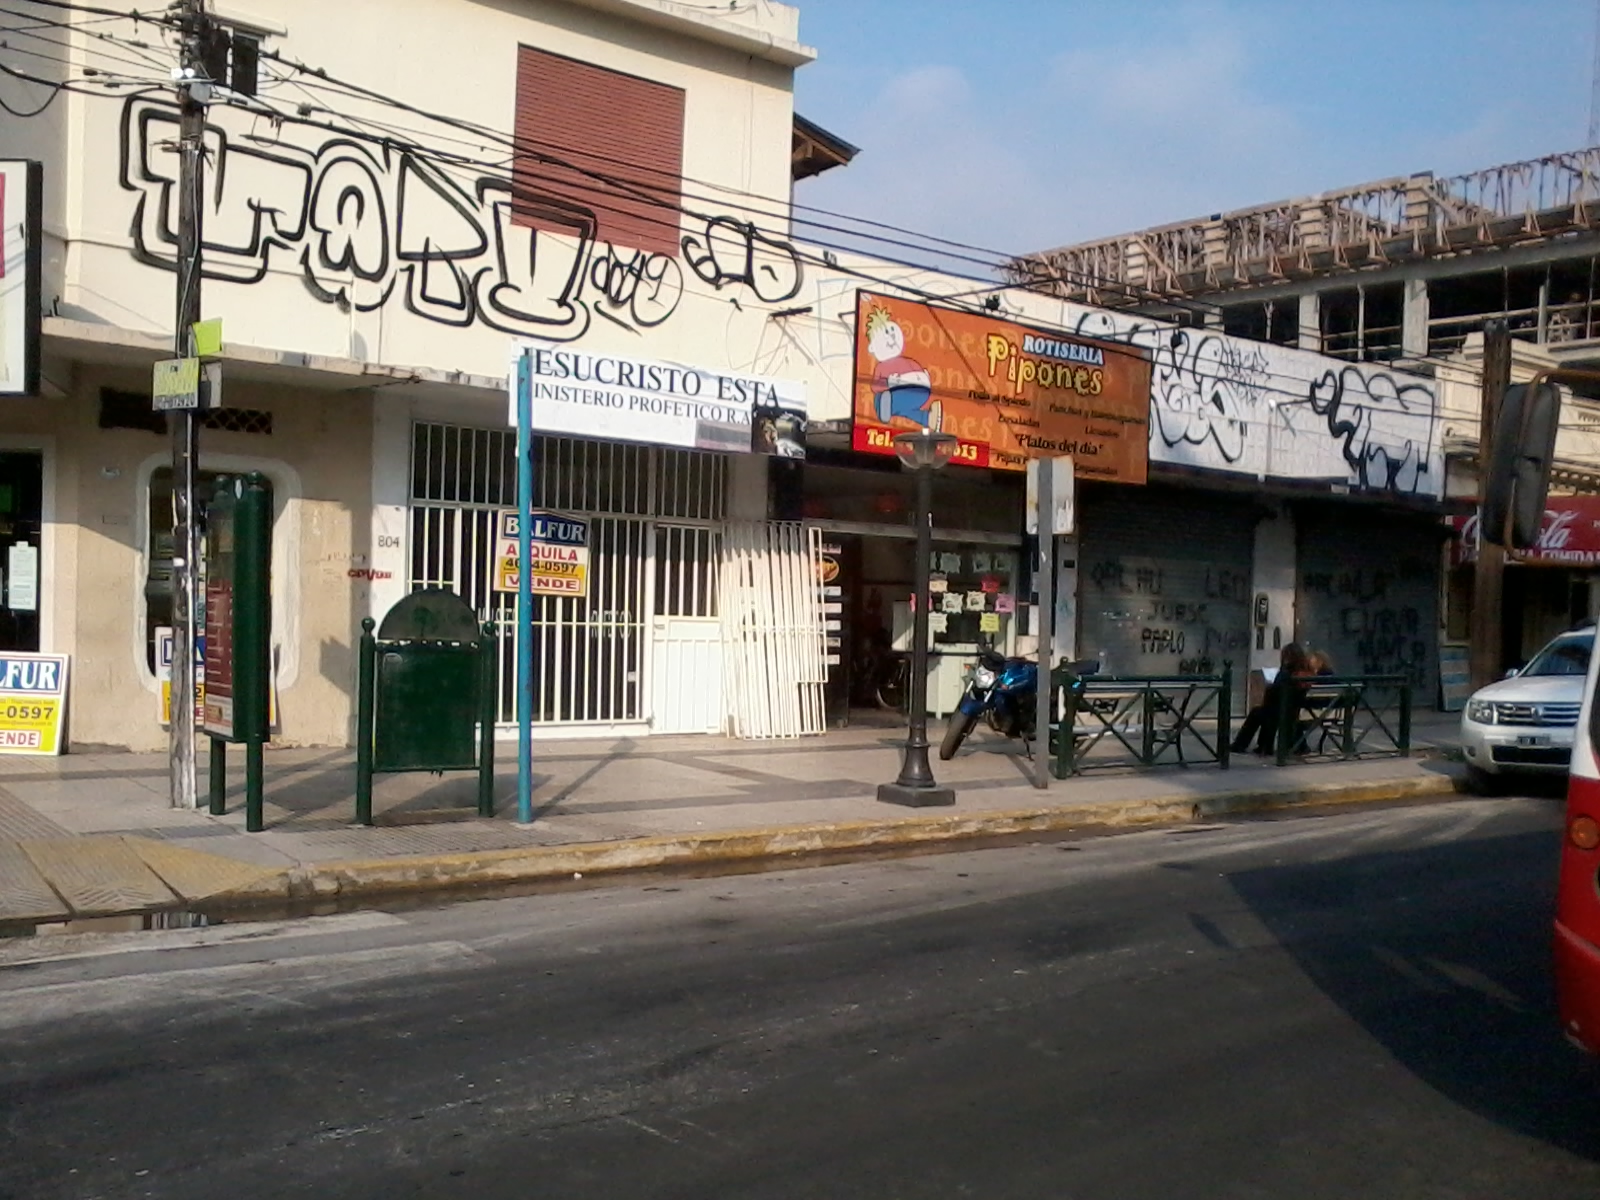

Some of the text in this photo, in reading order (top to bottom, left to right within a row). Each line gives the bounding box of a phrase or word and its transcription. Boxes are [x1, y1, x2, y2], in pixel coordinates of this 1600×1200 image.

[1022, 334, 1105, 366] ROTISERIA
[986, 332, 1105, 397] Pipones
[533, 381, 624, 409] INISTERIO
[628, 395, 722, 422] PROFETICO
[716, 375, 780, 408] ESTA
[866, 428, 894, 448] Tel.
[1059, 440, 1078, 454] del
[505, 516, 585, 541] BLFUR
[378, 535, 399, 548] 804
[506, 543, 578, 562] AQUILA
